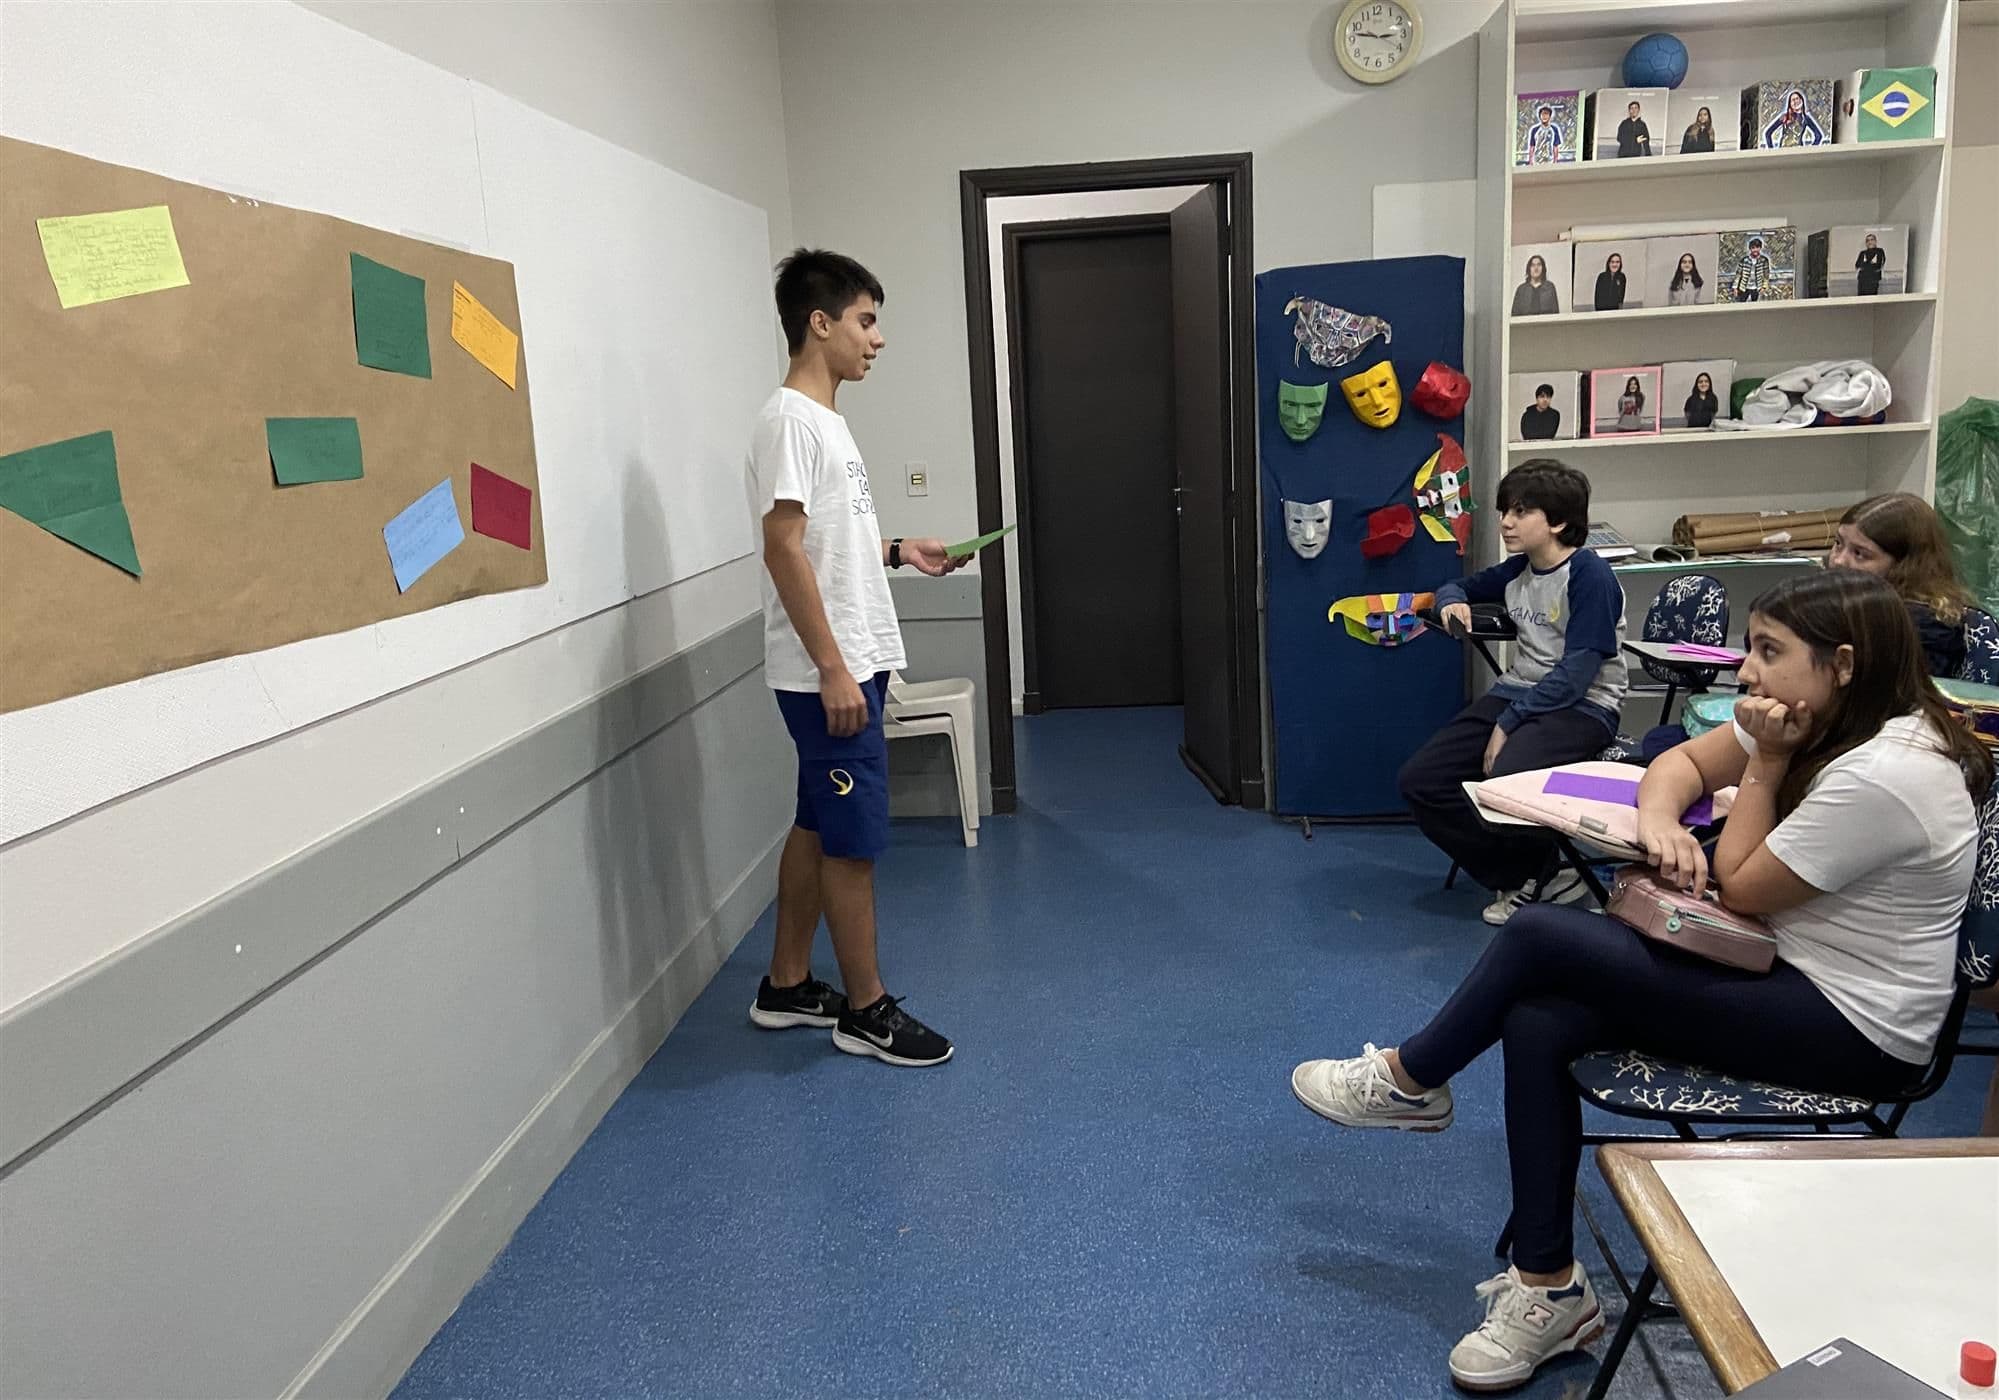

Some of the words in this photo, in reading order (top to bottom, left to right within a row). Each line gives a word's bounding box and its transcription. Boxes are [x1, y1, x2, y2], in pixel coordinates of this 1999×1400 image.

[1361, 11, 1370, 21] 11
[1372, 5, 1382, 16] 12
[1388, 7, 1392, 17] 1
[1352, 21, 1362, 32] 10
[1395, 16, 1403, 26] 2
[1400, 28, 1407, 39] 3
[1348, 35, 1356, 46] 9
[1353, 48, 1361, 58] 8
[1396, 43, 1403, 53] 4
[1363, 56, 1370, 67] 7
[1375, 57, 1382, 68] 6
[1387, 52, 1395, 64] 5
